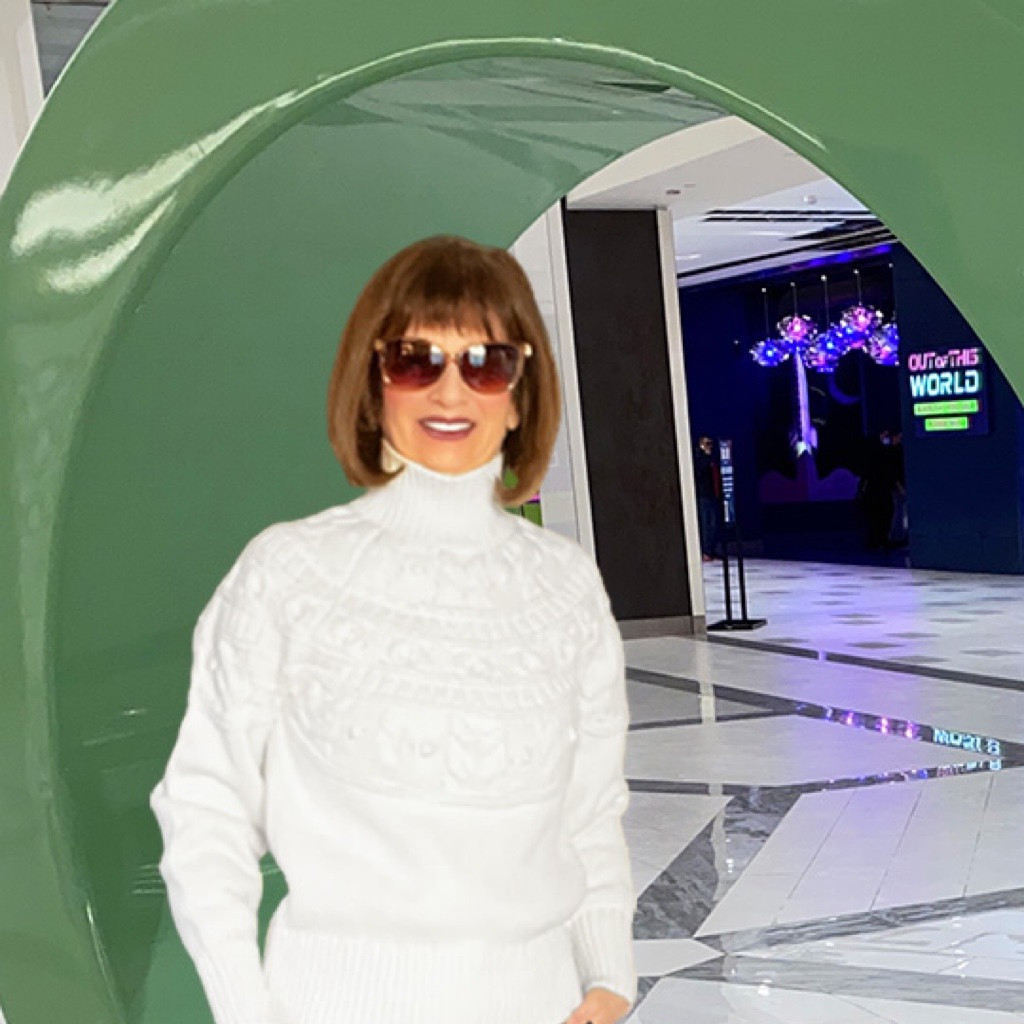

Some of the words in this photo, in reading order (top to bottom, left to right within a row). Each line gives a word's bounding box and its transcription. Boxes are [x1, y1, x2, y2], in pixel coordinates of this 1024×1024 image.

[908, 352, 935, 371] OUT
[948, 347, 980, 368] THIS
[909, 369, 980, 398] WORLD
